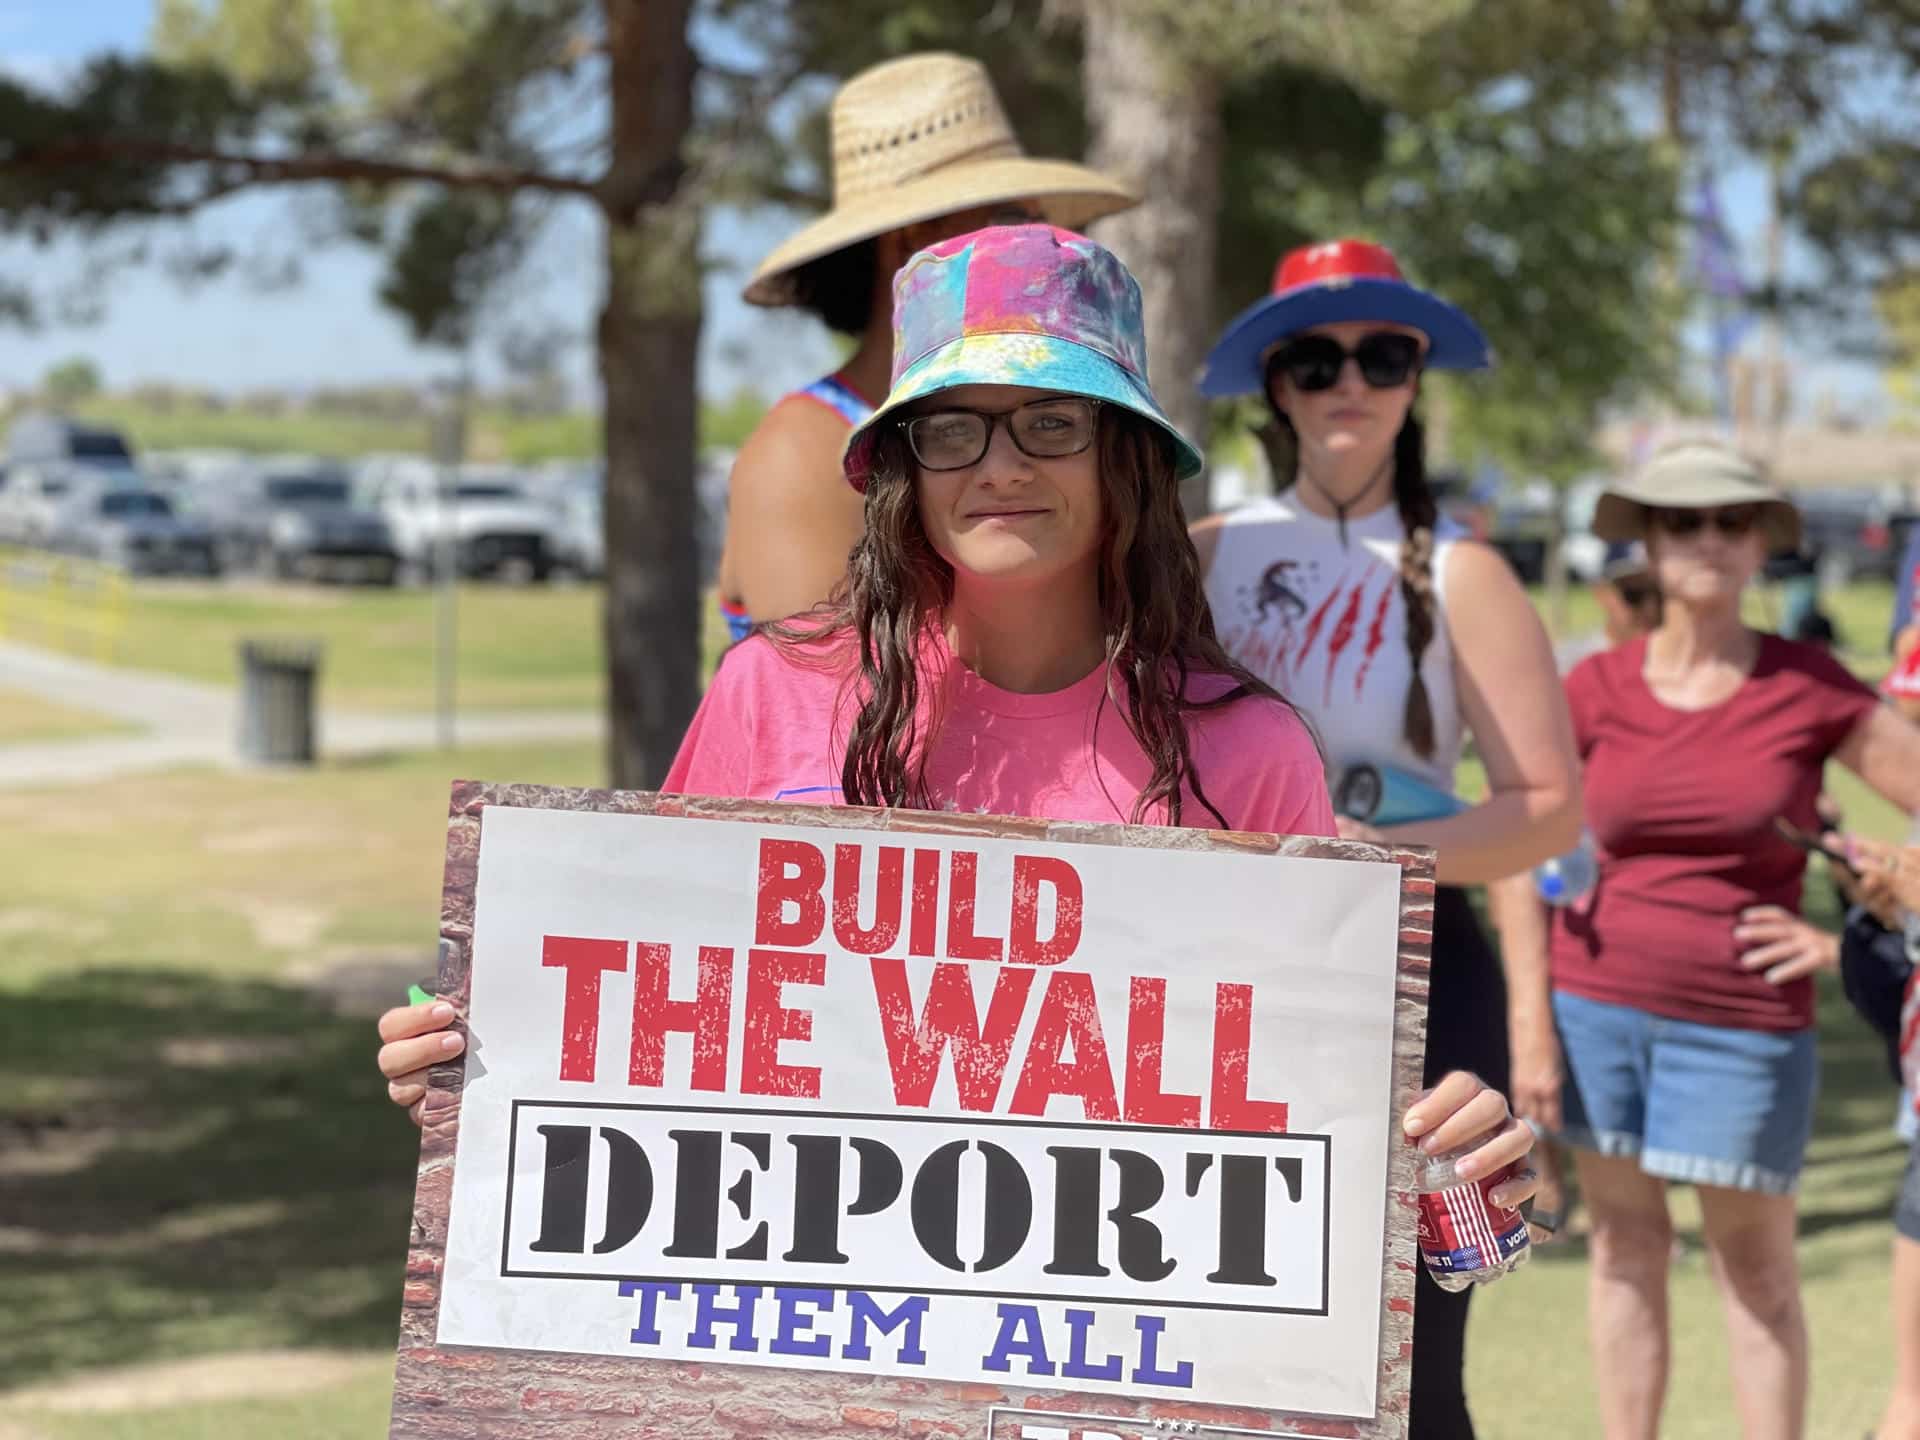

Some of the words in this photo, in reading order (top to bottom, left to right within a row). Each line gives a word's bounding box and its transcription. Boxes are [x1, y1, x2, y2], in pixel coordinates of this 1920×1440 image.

[754, 838, 1084, 966] BUILD
[543, 935, 827, 1099] THE
[869, 957, 1289, 1134] WALL
[529, 1124, 1303, 1287] DEPORT
[618, 1280, 930, 1365] THEM
[982, 1303, 1194, 1389] ALL
